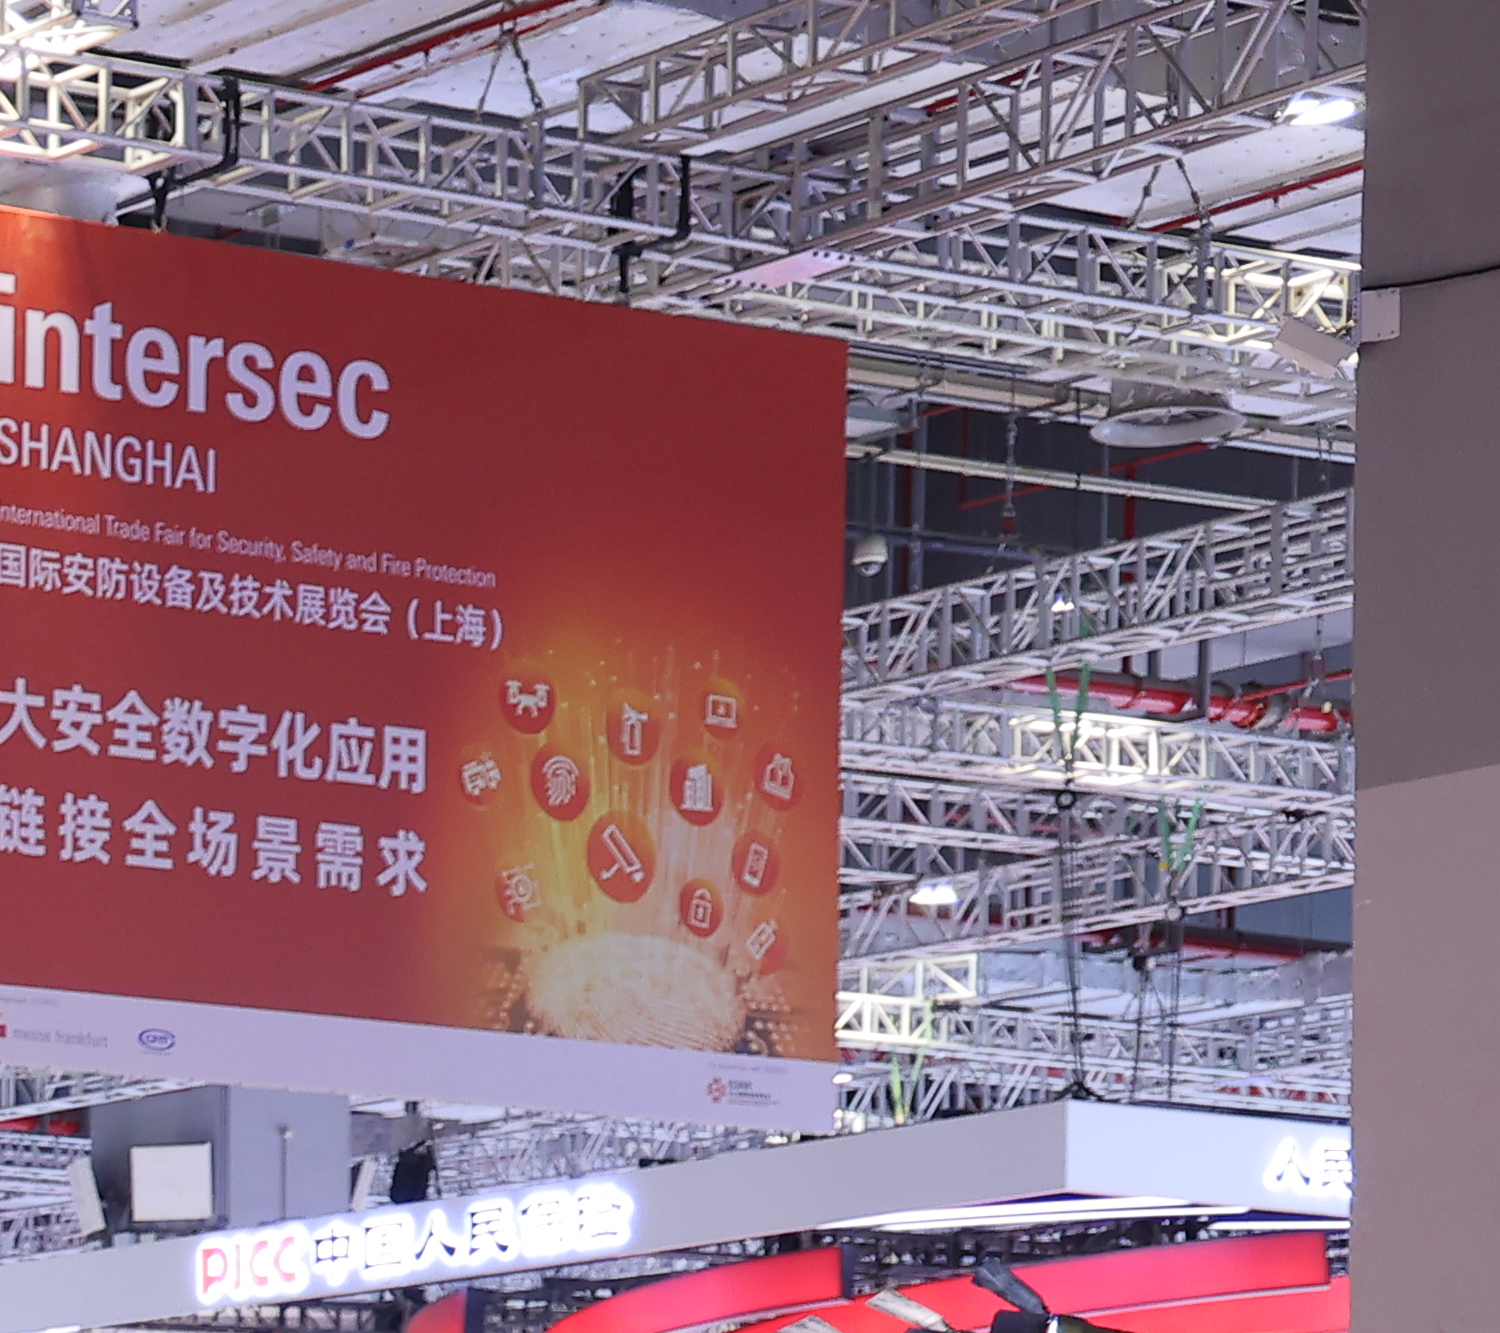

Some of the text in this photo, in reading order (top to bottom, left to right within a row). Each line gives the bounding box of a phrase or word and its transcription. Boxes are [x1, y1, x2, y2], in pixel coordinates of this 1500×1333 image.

[105, 514, 151, 542] Trade
[154, 522, 184, 546] Fair
[189, 526, 212, 550] for
[291, 540, 343, 571] Safety
[345, 550, 376, 573] and
[381, 553, 411, 578] Fire
[415, 557, 497, 589] Protection
[202, 1236, 296, 1295] PICC
